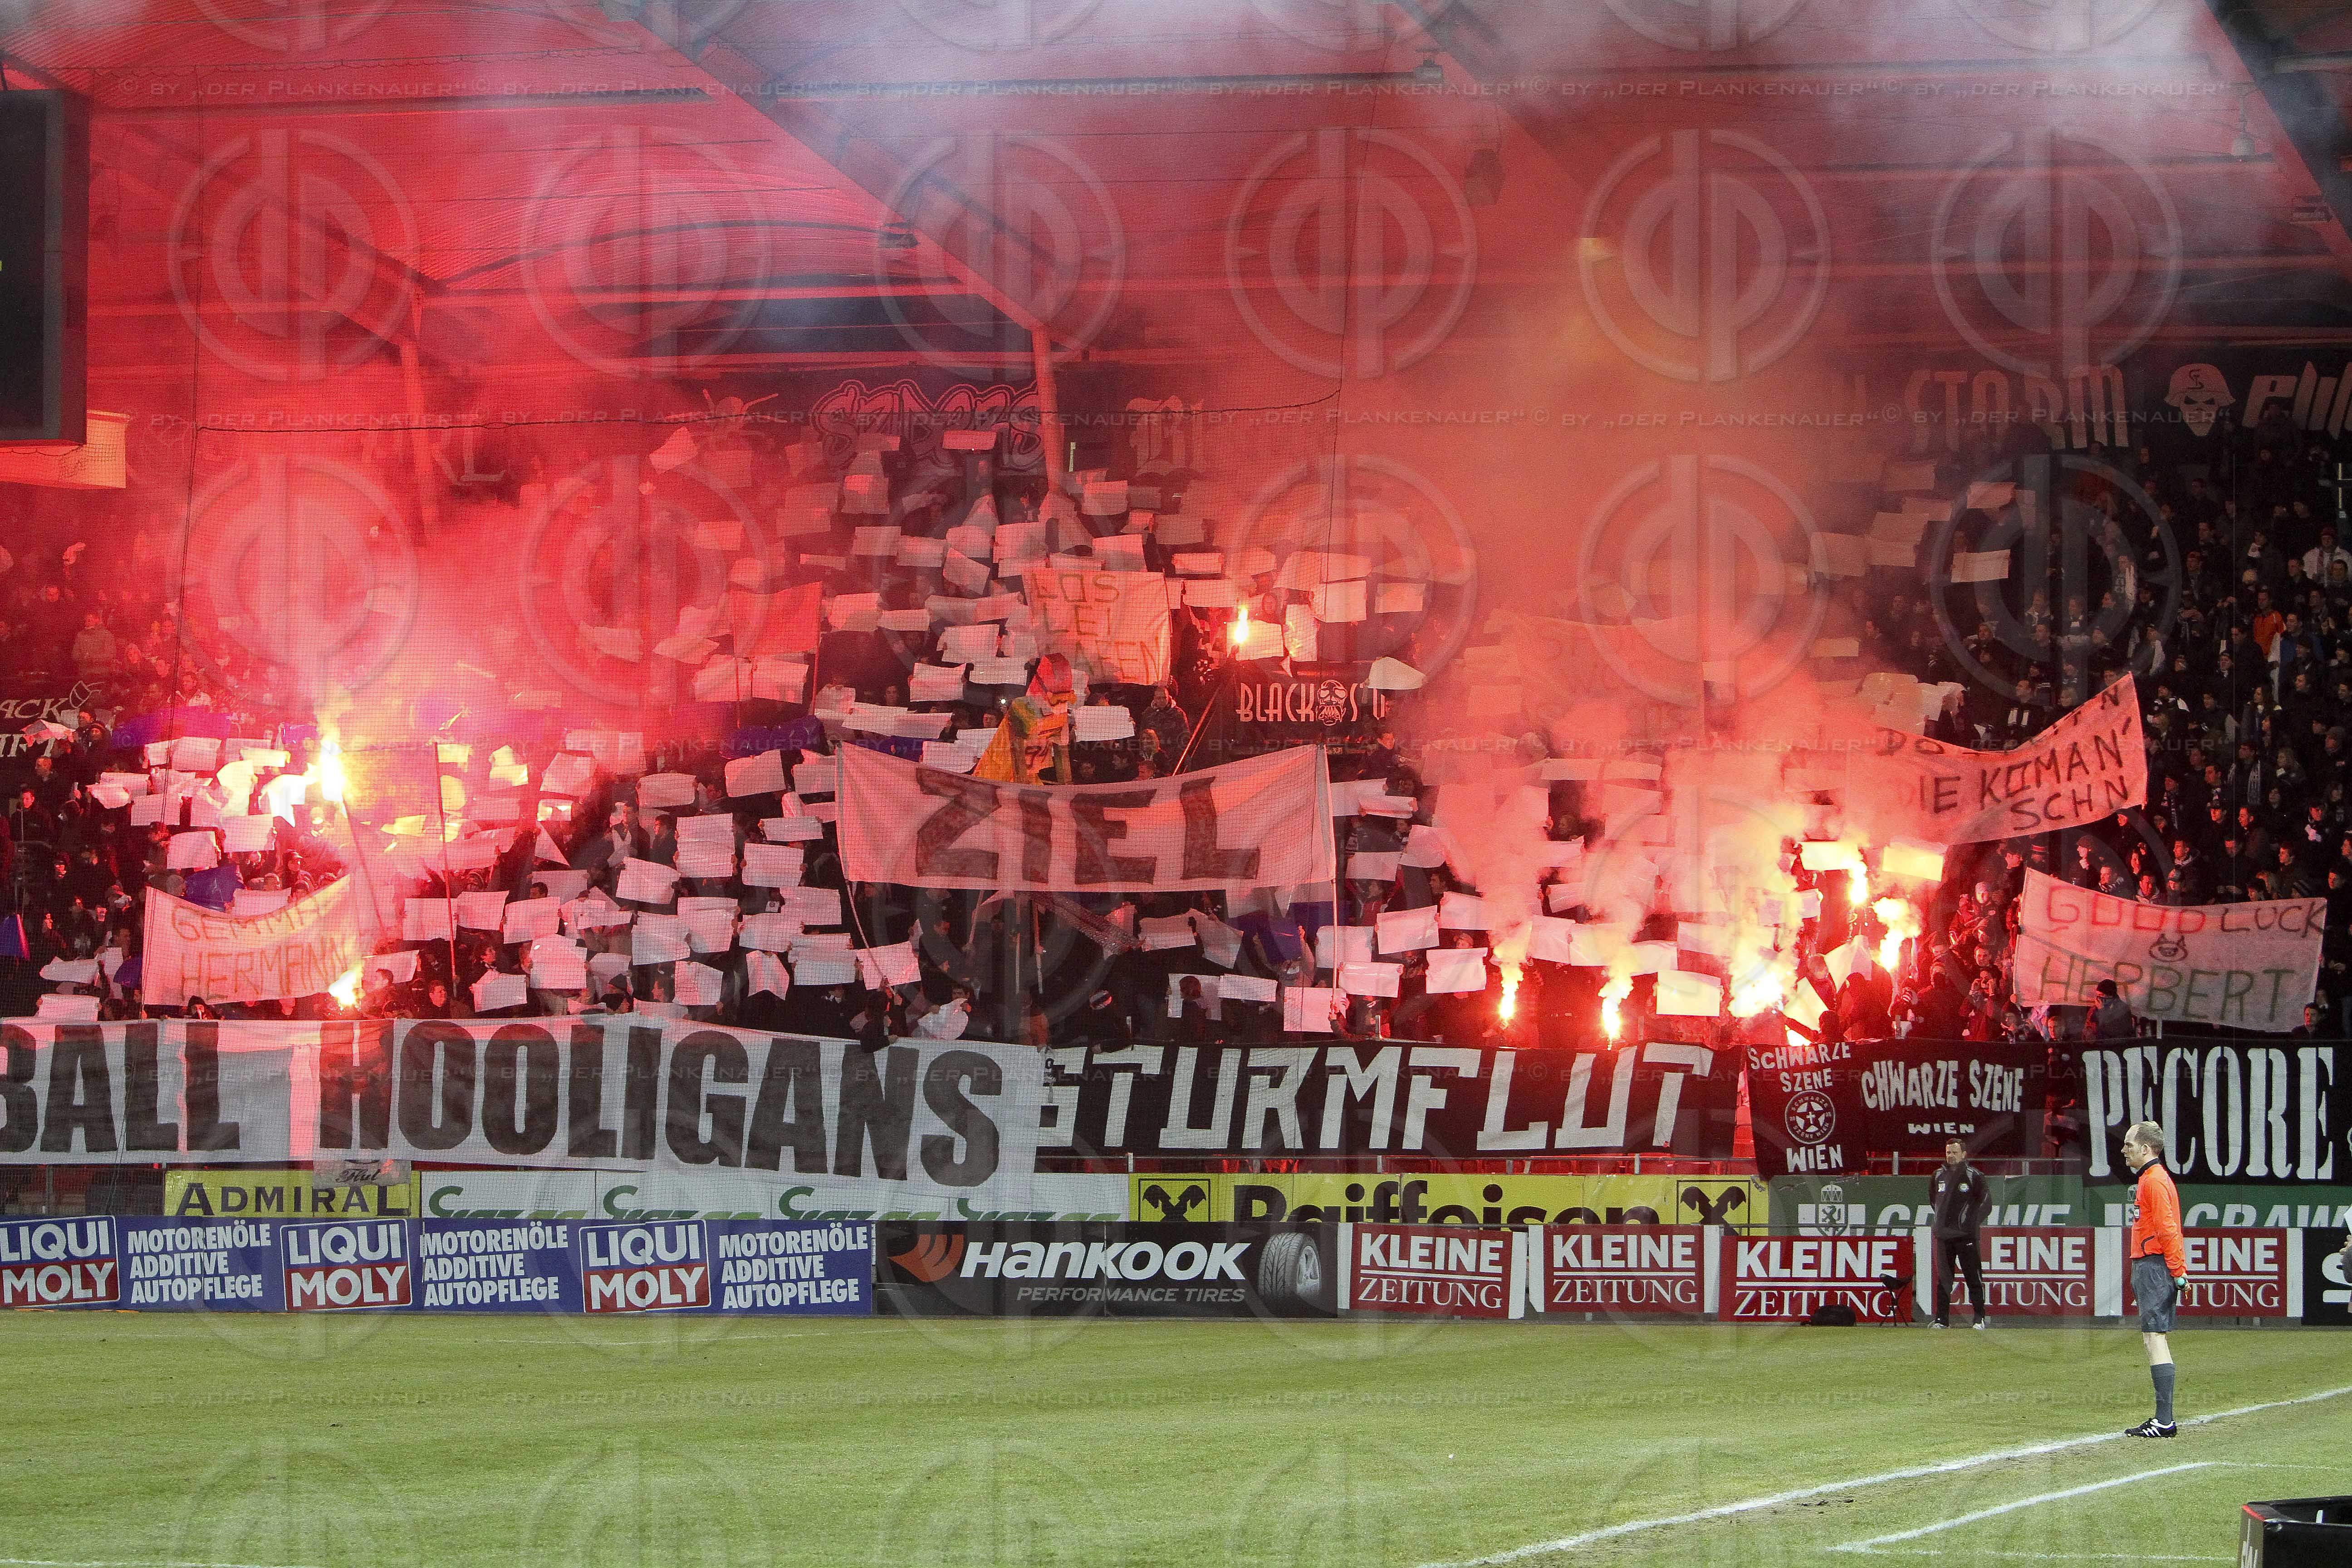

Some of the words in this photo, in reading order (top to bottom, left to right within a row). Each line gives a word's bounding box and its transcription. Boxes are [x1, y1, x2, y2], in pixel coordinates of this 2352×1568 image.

[1235, 682, 1315, 722] BLACK
[915, 767, 1260, 884] ZIEL
[2046, 885, 2206, 934] GOOD
[2221, 906, 2326, 938] LUCK
[181, 936, 348, 1000] HERMANN
[2039, 956, 2296, 1022] HERBERT
[1748, 1042, 1852, 1070] SCHWARZE
[1040, 1042, 1714, 1150] STURMFLUT
[1779, 1068, 1833, 1093] SZENE
[1861, 1059, 1958, 1112] CHWARZE
[1970, 1059, 2024, 1112] SZENE
[320, 1020, 1003, 1187] HOOLIGANS
[1907, 1122, 1975, 1134] WIEN
[1786, 1144, 1843, 1173] WIEN
[177, 1182, 411, 1216] ADMIRAL
[1, 1219, 110, 1263] LIQUI
[127, 1219, 271, 1254] MOTORENÖLE
[287, 1223, 402, 1265] LIQUI
[423, 1220, 569, 1256] MOTORENÖLE
[586, 1224, 700, 1268] LIQUI
[719, 1221, 869, 1258] MOTORENÖLE
[1361, 1233, 1504, 1273] KLEINE
[1553, 1233, 1696, 1269] KLEINE
[130, 1251, 229, 1279] ADDITIVE
[423, 1253, 524, 1281] ADDITIVE
[721, 1255, 824, 1284] ADDITIVE
[1736, 1241, 1898, 1278] KLEINE
[3, 1261, 116, 1303] MOLY
[130, 1274, 264, 1304] AUTOPFLEGE
[291, 1266, 407, 1308] MOLY
[424, 1276, 560, 1307] AUTOPFLEGE
[589, 1267, 706, 1310] MOLY
[723, 1278, 860, 1310] AUTOPFLEGE
[1016, 1287, 1177, 1303] PERFORMANCE
[1184, 1287, 1246, 1303] TIRES
[1357, 1276, 1503, 1308] ZEITUNG
[1553, 1278, 1698, 1304] ZEITUNG
[1734, 1289, 1896, 1318] ZEITUNG
